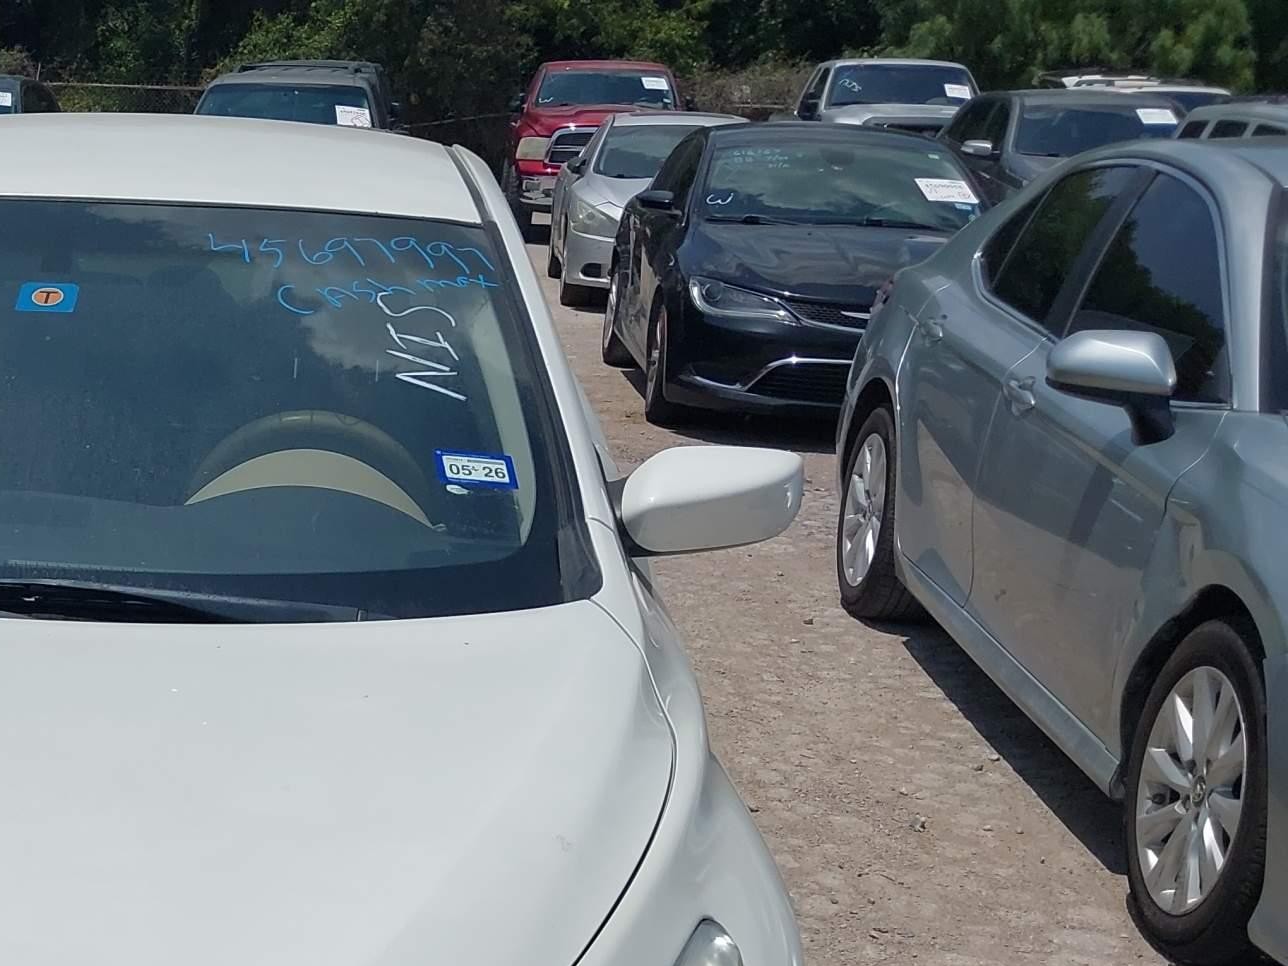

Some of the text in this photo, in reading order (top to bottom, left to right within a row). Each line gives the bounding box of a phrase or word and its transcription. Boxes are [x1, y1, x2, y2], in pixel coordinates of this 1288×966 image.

[208, 233, 495, 274] 45697997
[39, 290, 59, 304] T
[449, 463, 506, 479] 05 26
